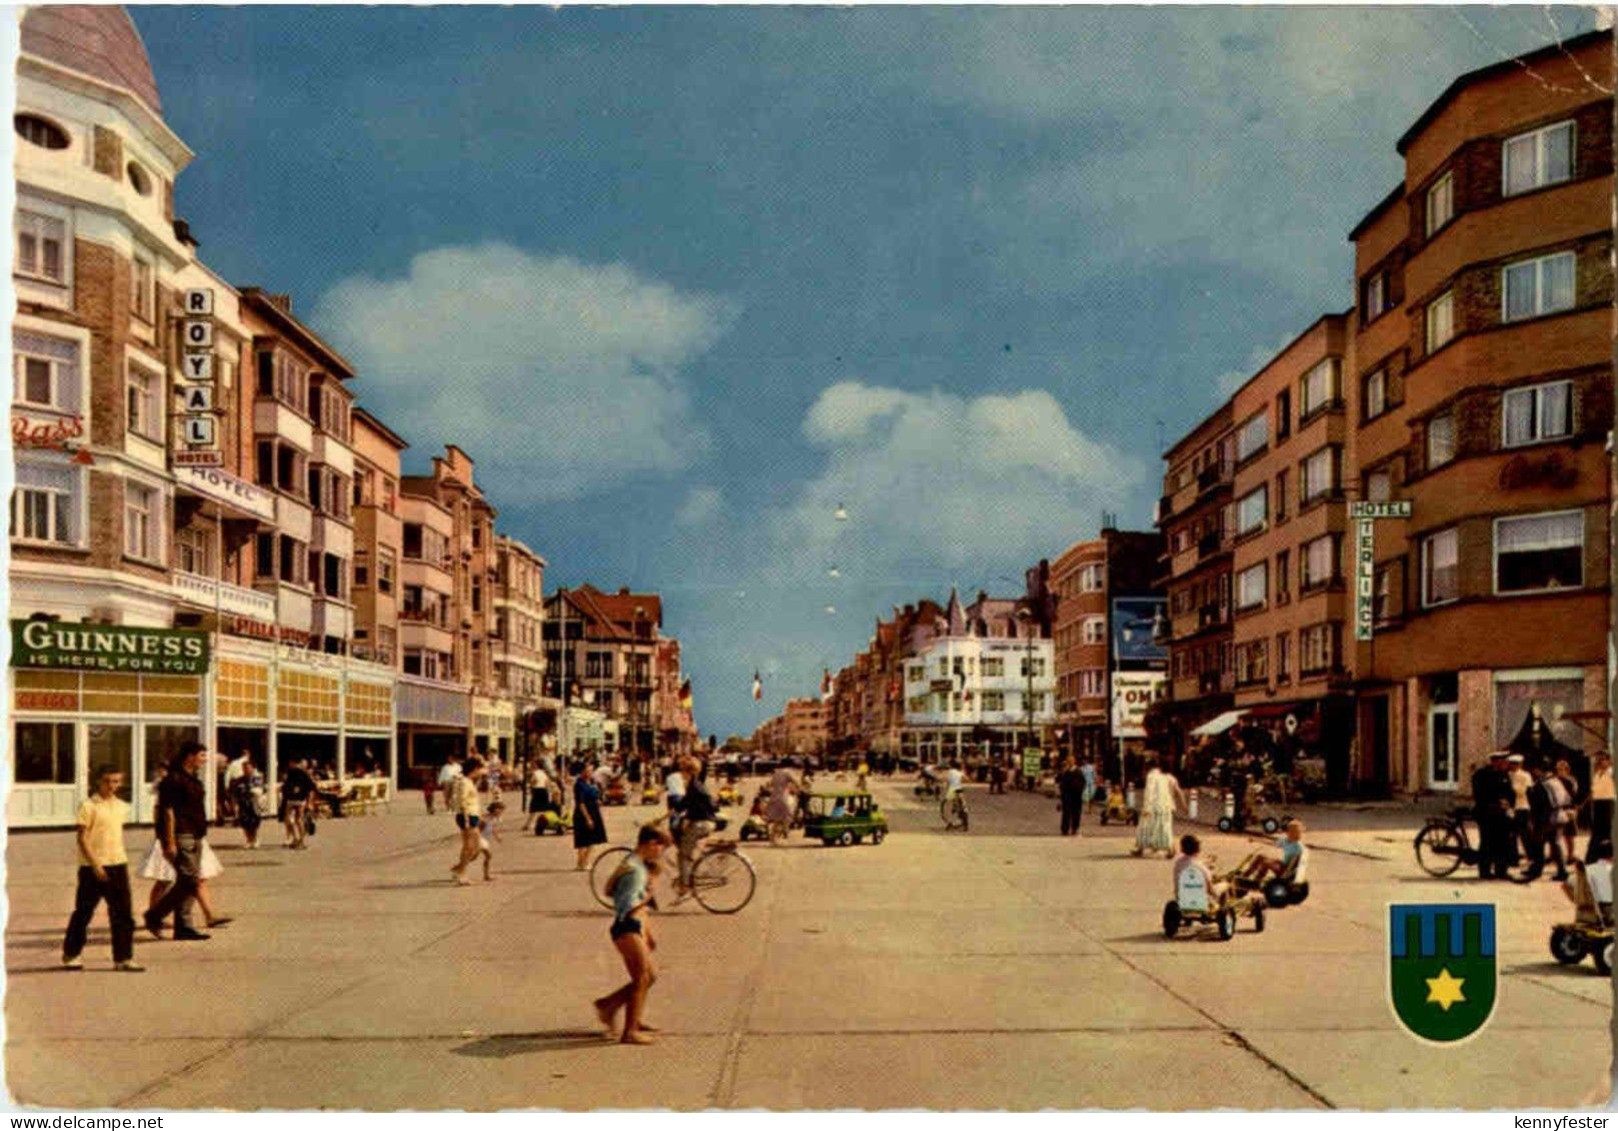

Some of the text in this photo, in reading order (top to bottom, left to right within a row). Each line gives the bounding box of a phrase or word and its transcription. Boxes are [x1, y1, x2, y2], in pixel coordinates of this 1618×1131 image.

[189, 292, 205, 440] ROYAL
[176, 453, 219, 464] HOTEL
[191, 466, 255, 501] HOTEL
[1353, 502, 1410, 516] HOTEL
[1359, 521, 1373, 636] TERLINCK
[29, 653, 49, 666] IS
[117, 657, 153, 669] FOR
[161, 659, 197, 671] YOU
